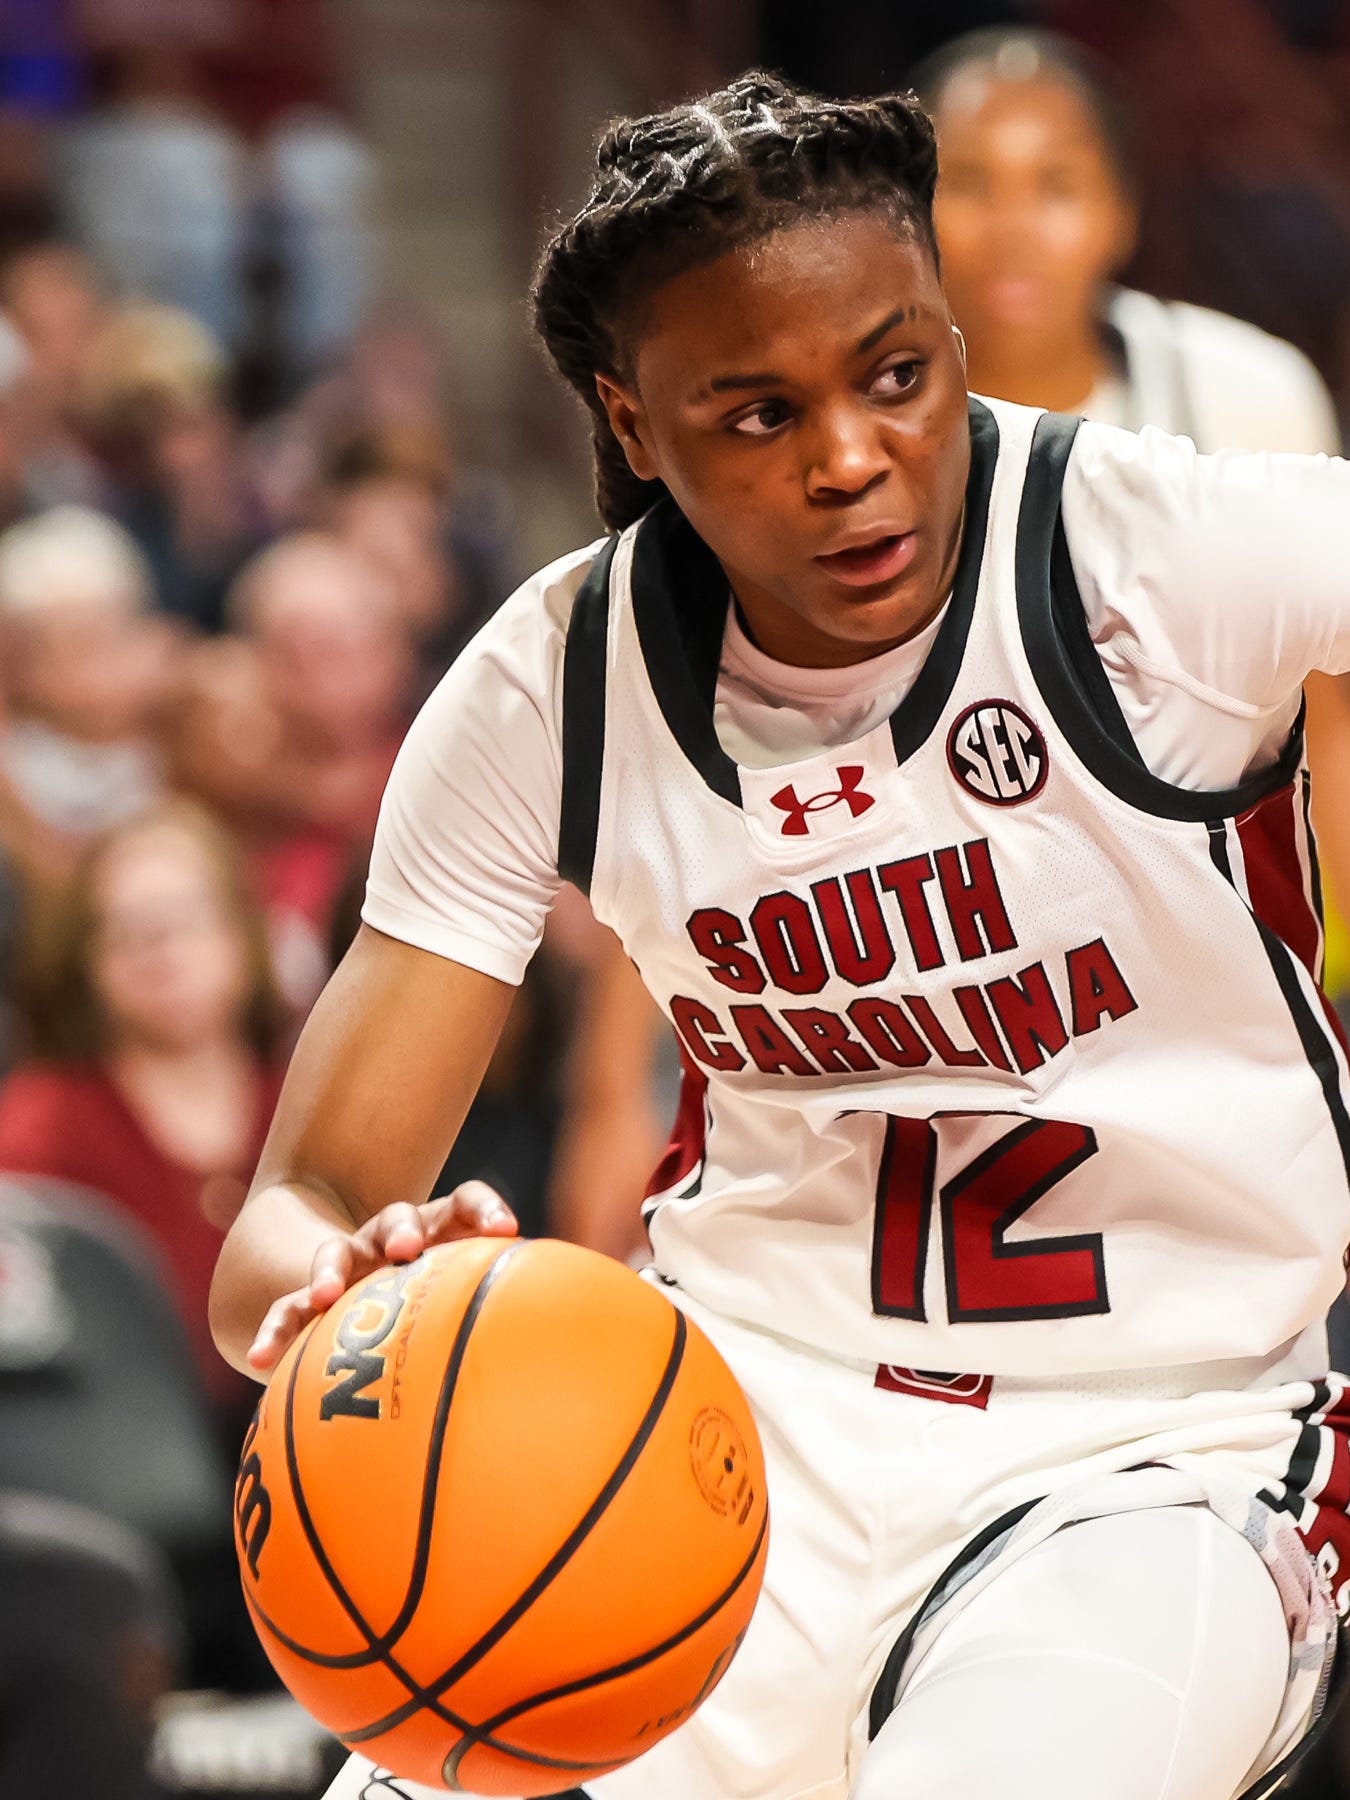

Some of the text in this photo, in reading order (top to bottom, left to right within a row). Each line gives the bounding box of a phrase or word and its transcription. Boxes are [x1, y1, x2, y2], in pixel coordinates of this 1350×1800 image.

[953, 705, 1043, 800] SEC
[685, 837, 1018, 995] SOUTH
[669, 937, 1138, 1076] CAROLINA
[838, 1109, 1111, 1325] 12
